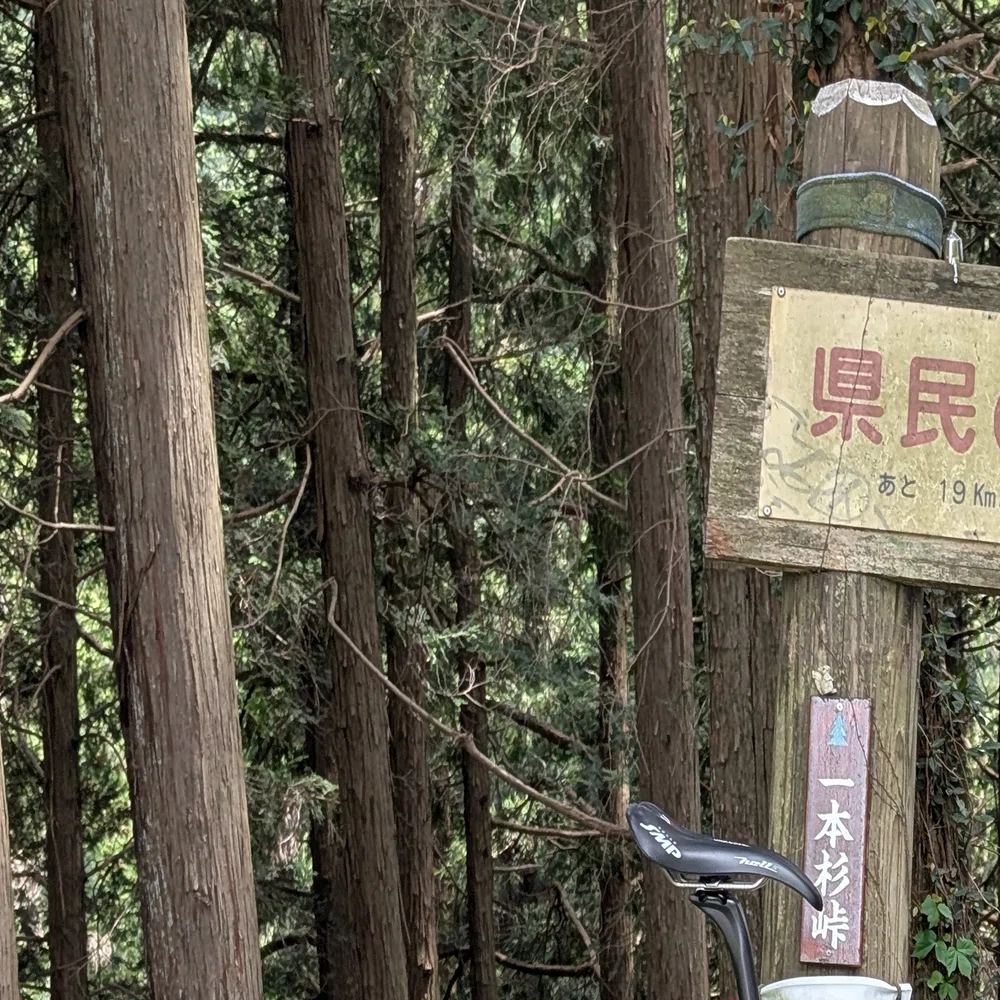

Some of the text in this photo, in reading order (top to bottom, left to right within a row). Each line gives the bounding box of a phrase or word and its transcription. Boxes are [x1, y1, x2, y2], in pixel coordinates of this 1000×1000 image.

[878, 472, 997, 508] あと 19 Km
[639, 822, 682, 859] SMP
[811, 777, 855, 950] 一本杉峠
